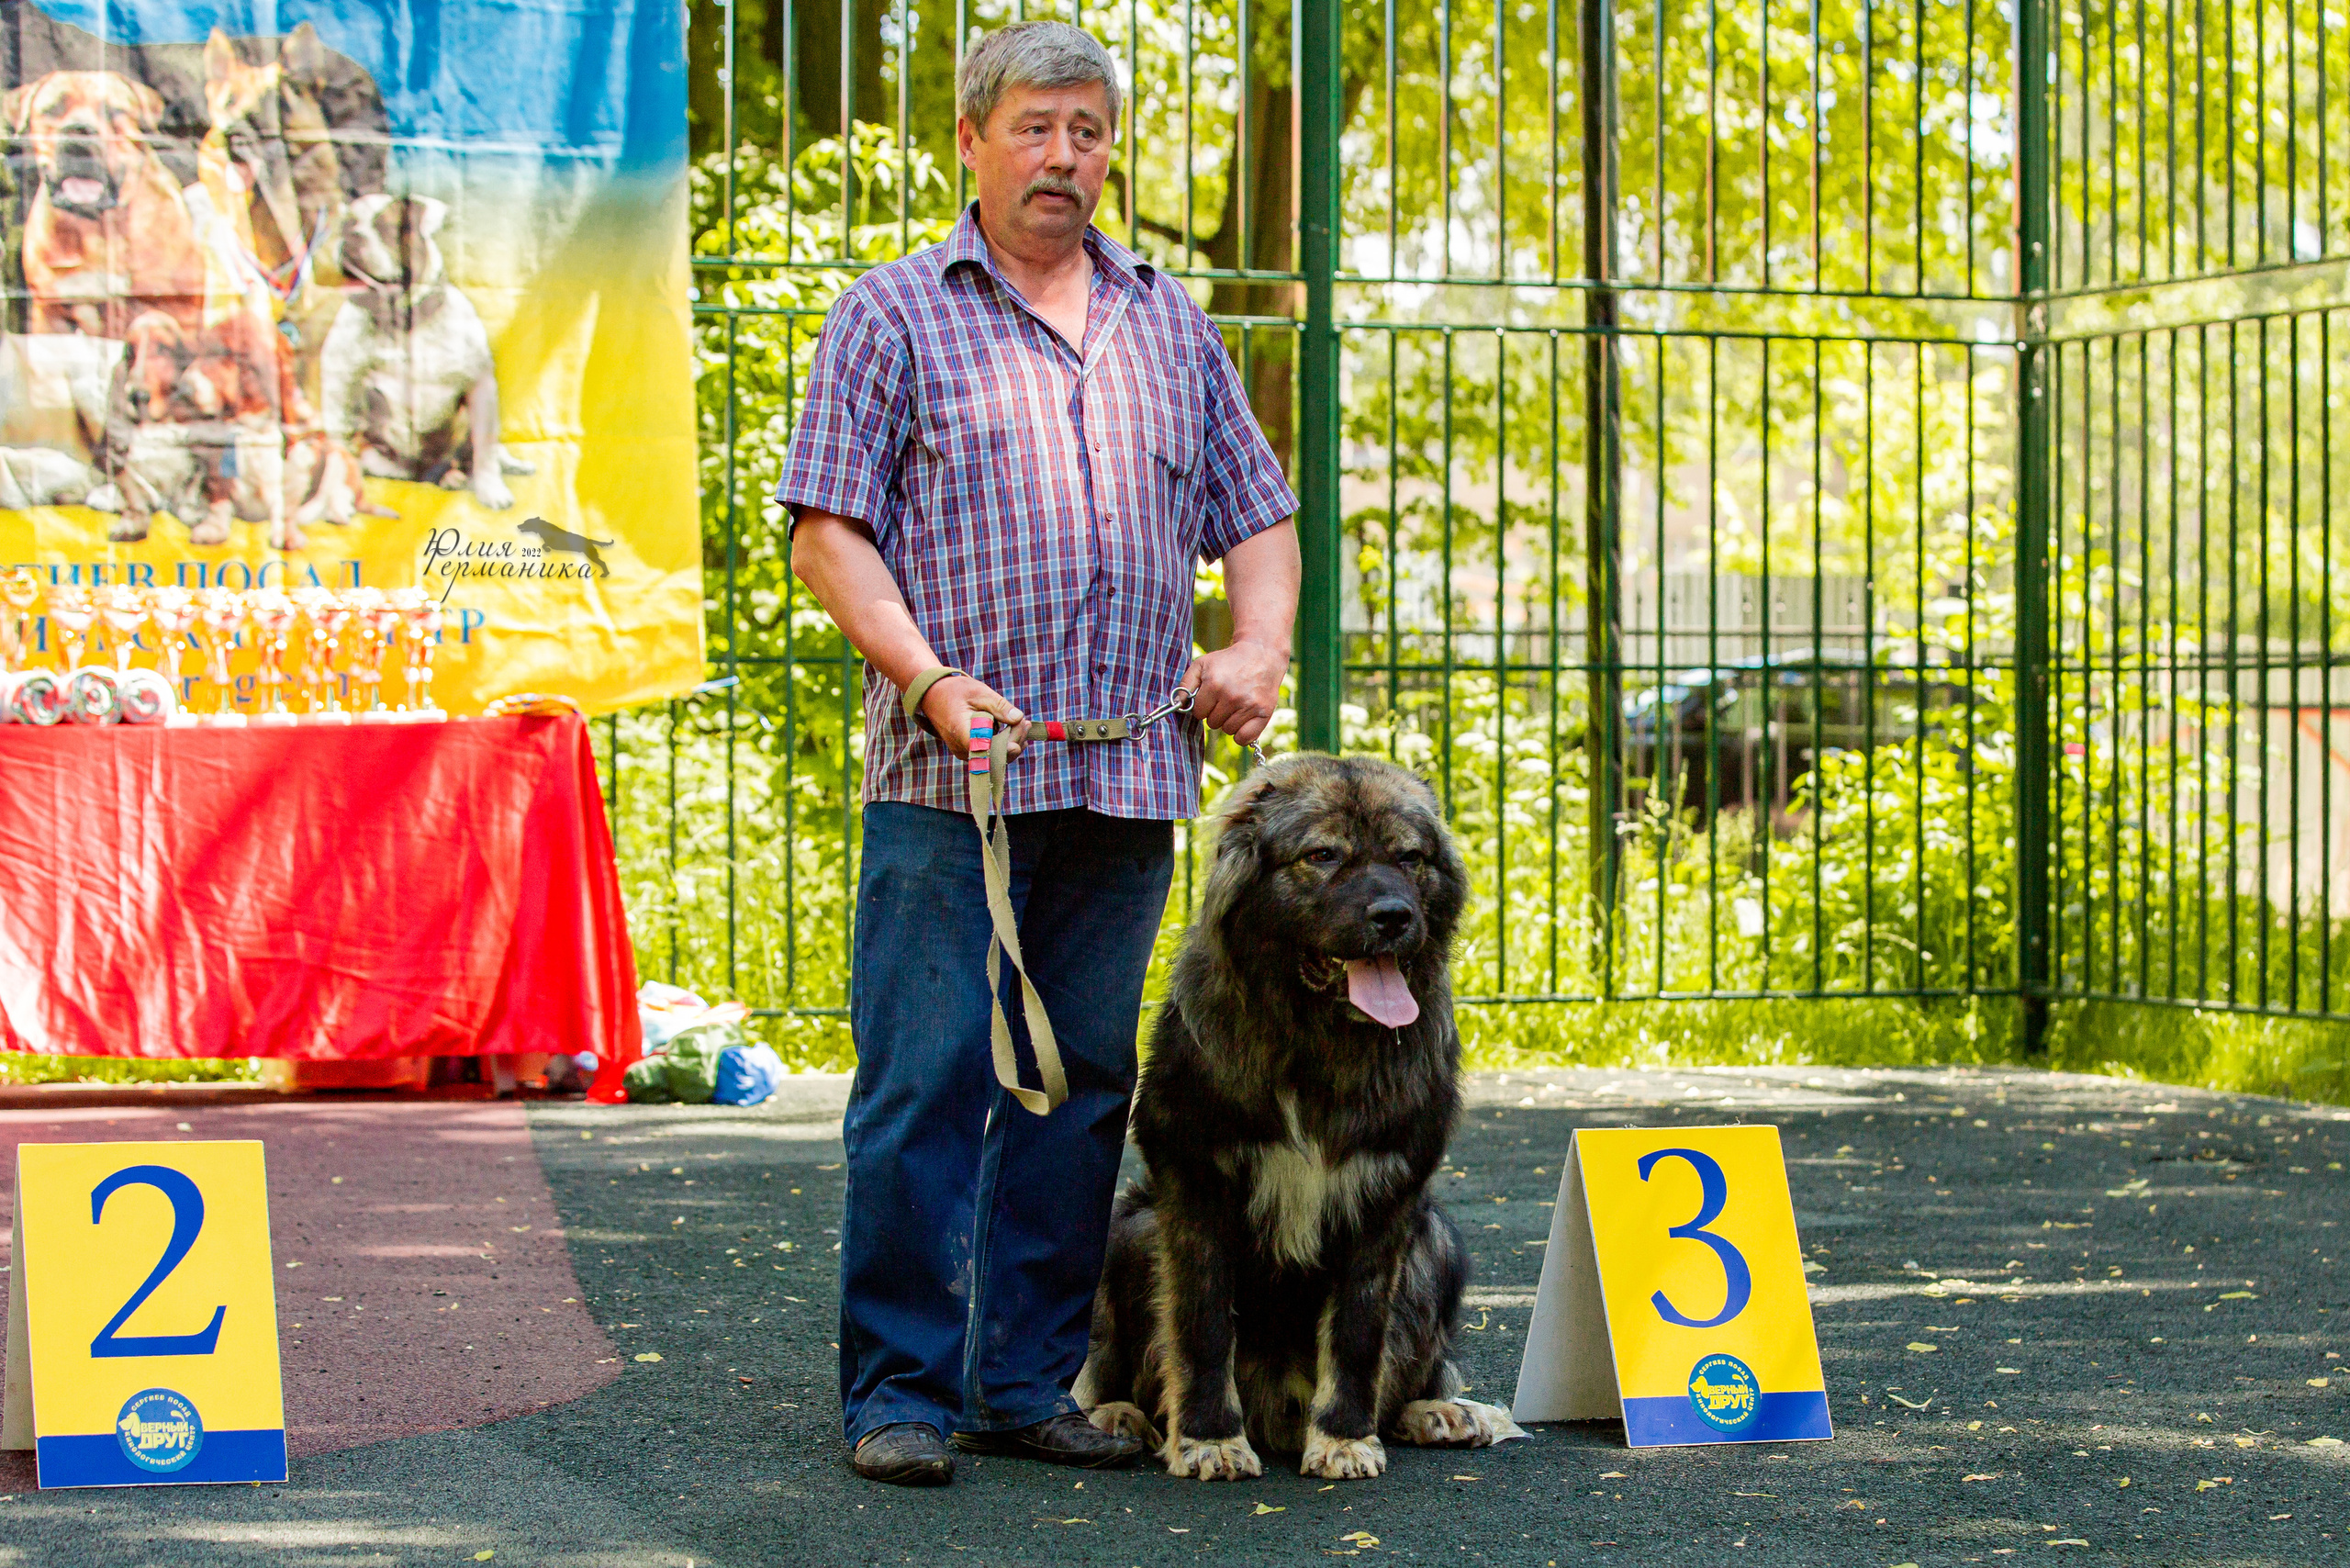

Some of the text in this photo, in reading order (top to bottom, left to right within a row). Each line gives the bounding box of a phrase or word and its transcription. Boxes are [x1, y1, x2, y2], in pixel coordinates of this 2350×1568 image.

[1637, 1148, 1751, 1328] 3
[90, 1165, 227, 1358] 2
[1698, 1360, 1749, 1380] СЕРГИЕВ ПОСАД
[131, 1394, 191, 1417] СЕРГИЕВ ПОСАД
[1708, 1394, 1750, 1409] ДРУГ
[138, 1432, 189, 1449] ДРУГ
